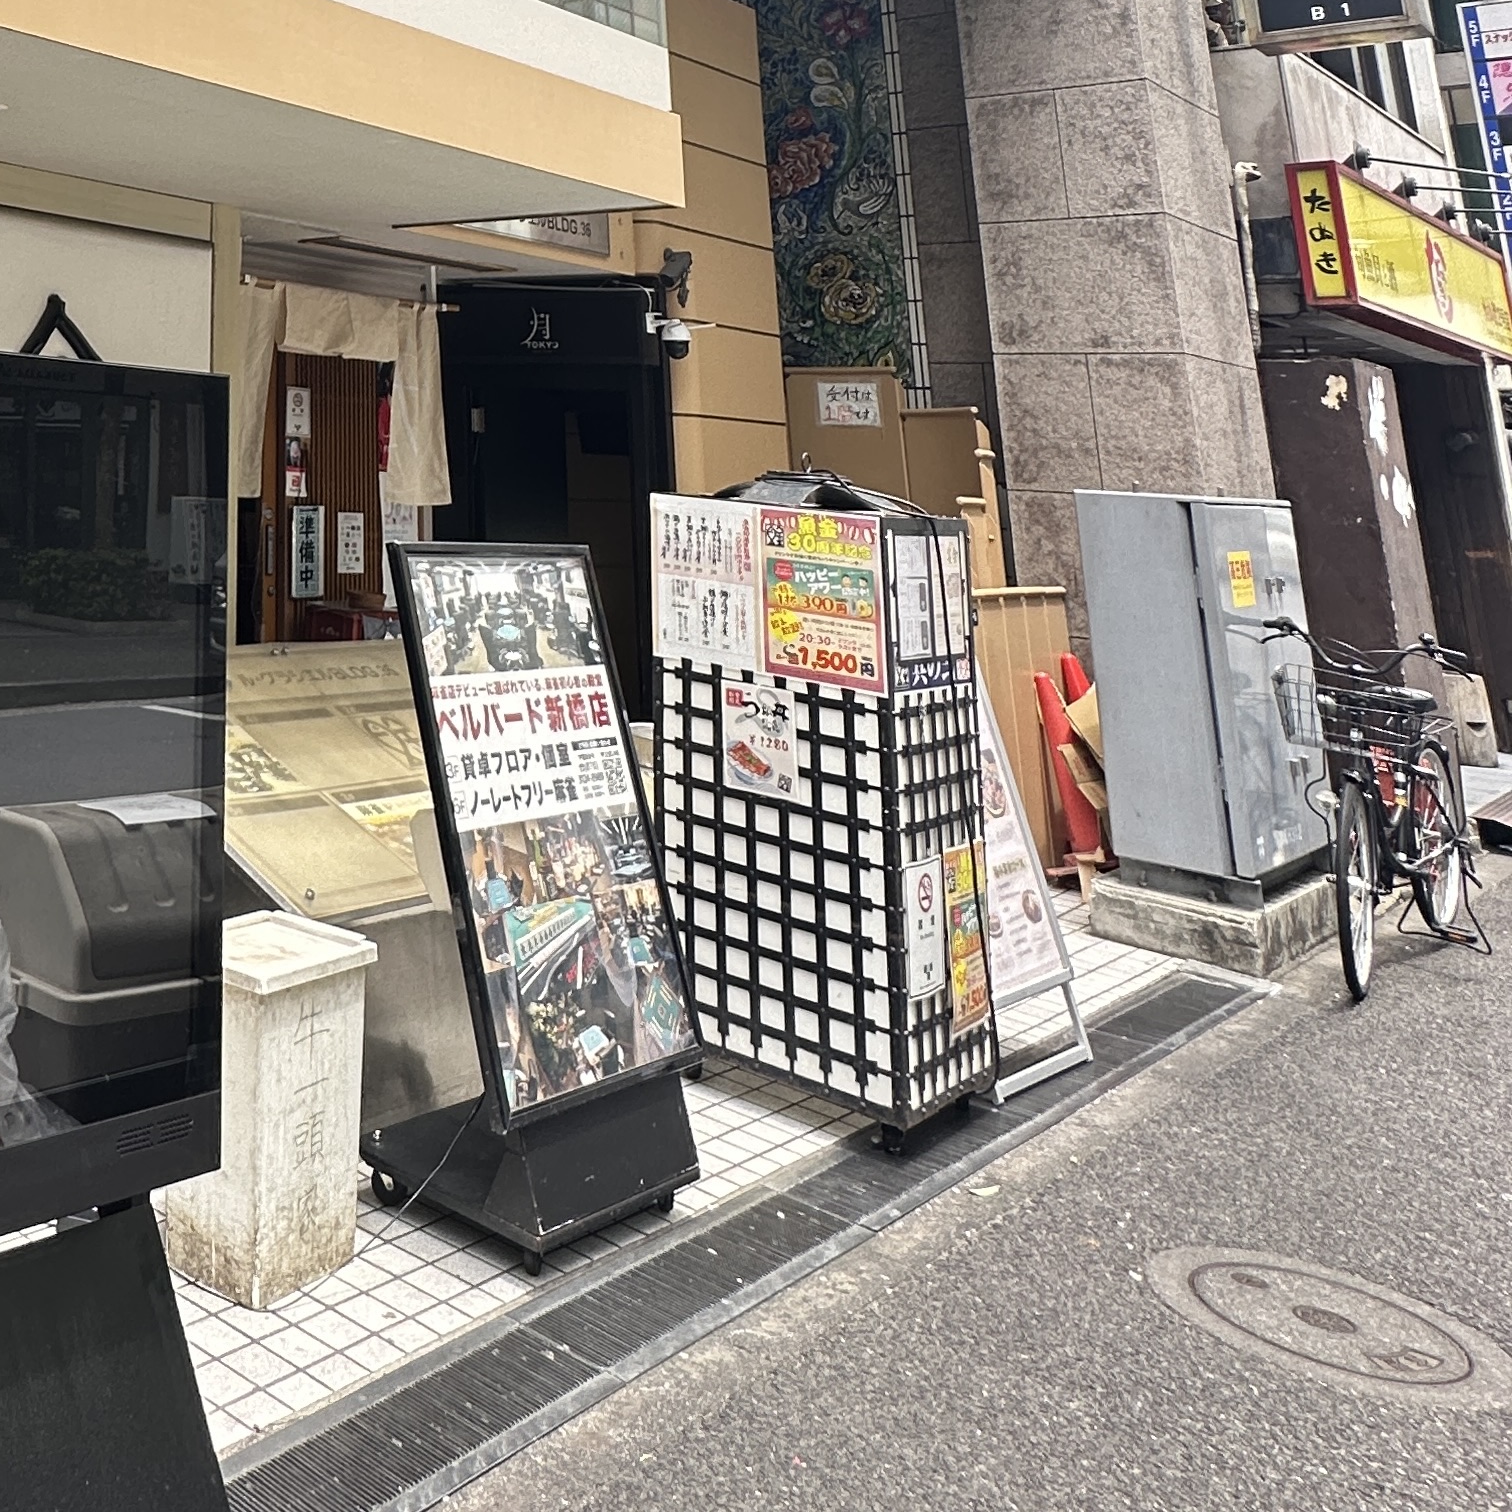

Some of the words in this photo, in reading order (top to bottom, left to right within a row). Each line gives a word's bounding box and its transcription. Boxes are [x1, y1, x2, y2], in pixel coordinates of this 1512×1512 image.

[1303, 188, 1339, 275] たぬき
[526, 340, 560, 350] TOKYO
[298, 514, 317, 589] 準備中
[794, 568, 840, 584] ハッピー
[807, 582, 842, 596] アワー
[438, 690, 612, 741] ベルバード新橋店
[470, 776, 579, 817] ノーレートフリー麻雀
